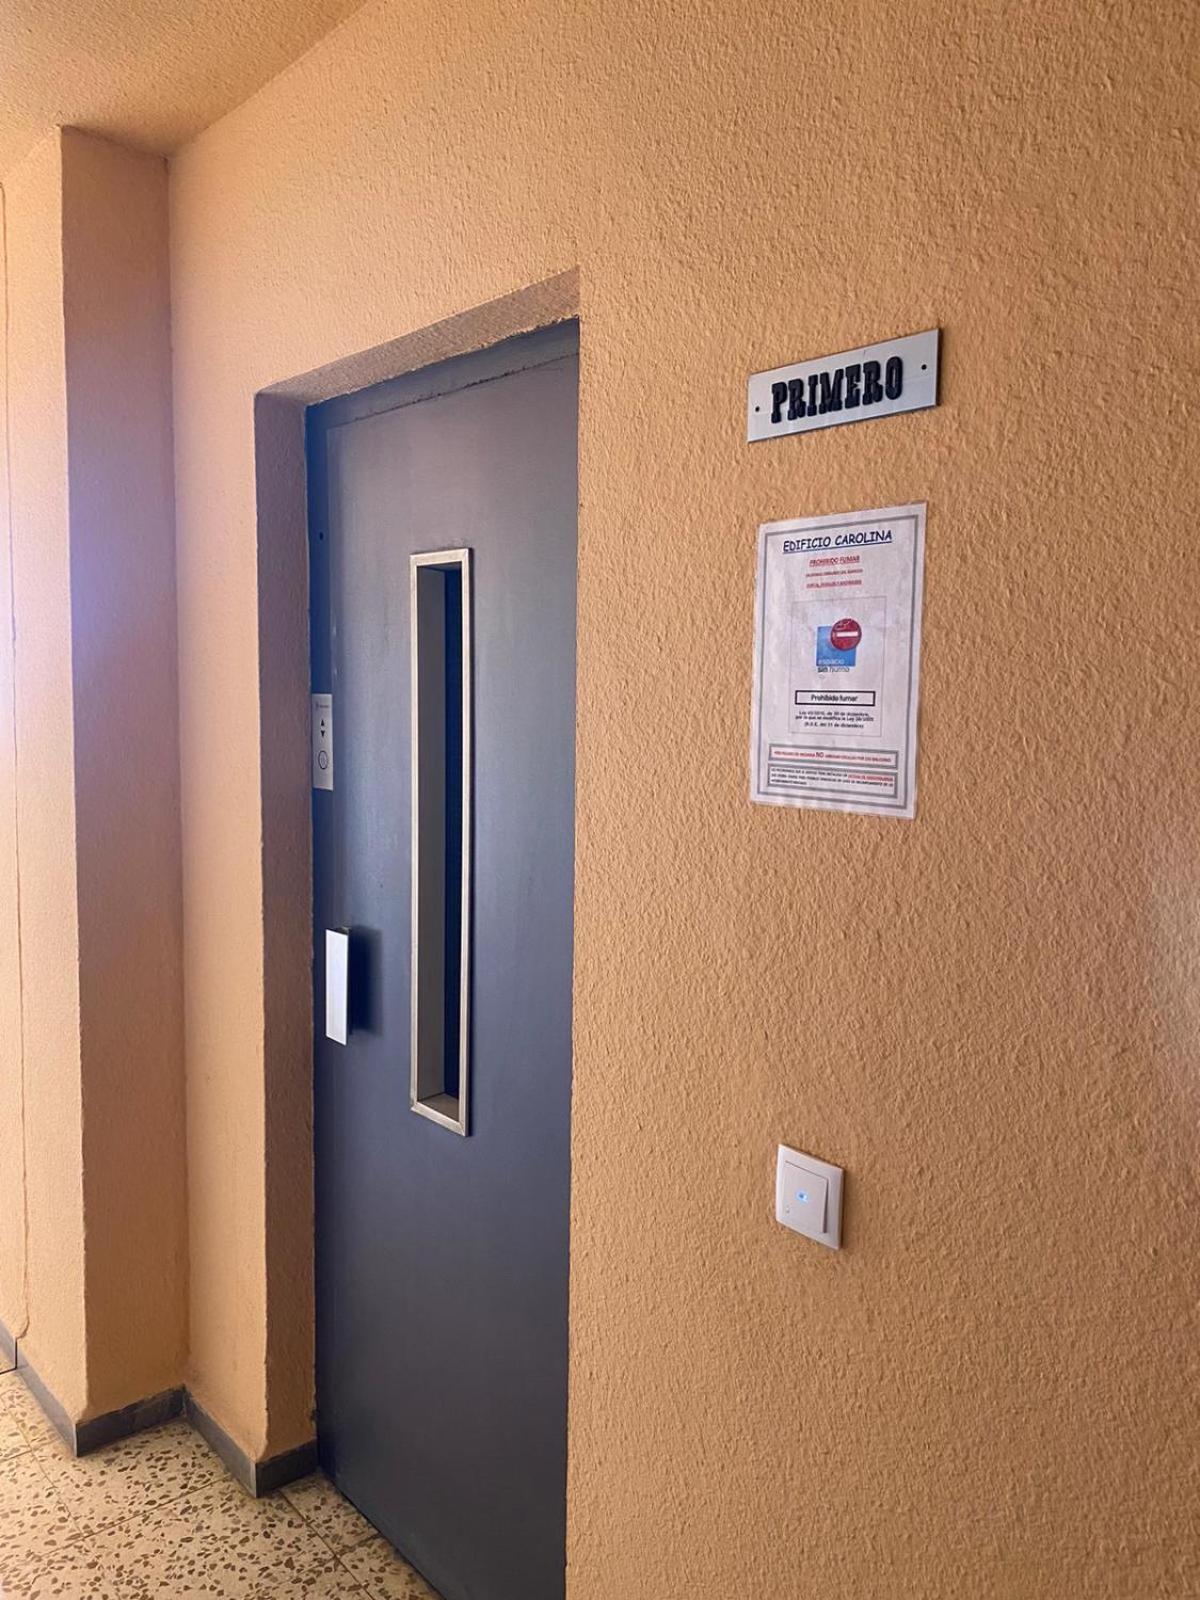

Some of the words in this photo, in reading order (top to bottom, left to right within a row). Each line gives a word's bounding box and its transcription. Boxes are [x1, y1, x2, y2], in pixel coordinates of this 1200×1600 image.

[771, 356, 903, 423] PRIMERO
[783, 537, 831, 552] EDIFICIO
[835, 530, 892, 546] CAROLINA
[811, 694, 838, 702] Prohibido
[839, 694, 858, 702] fumar
